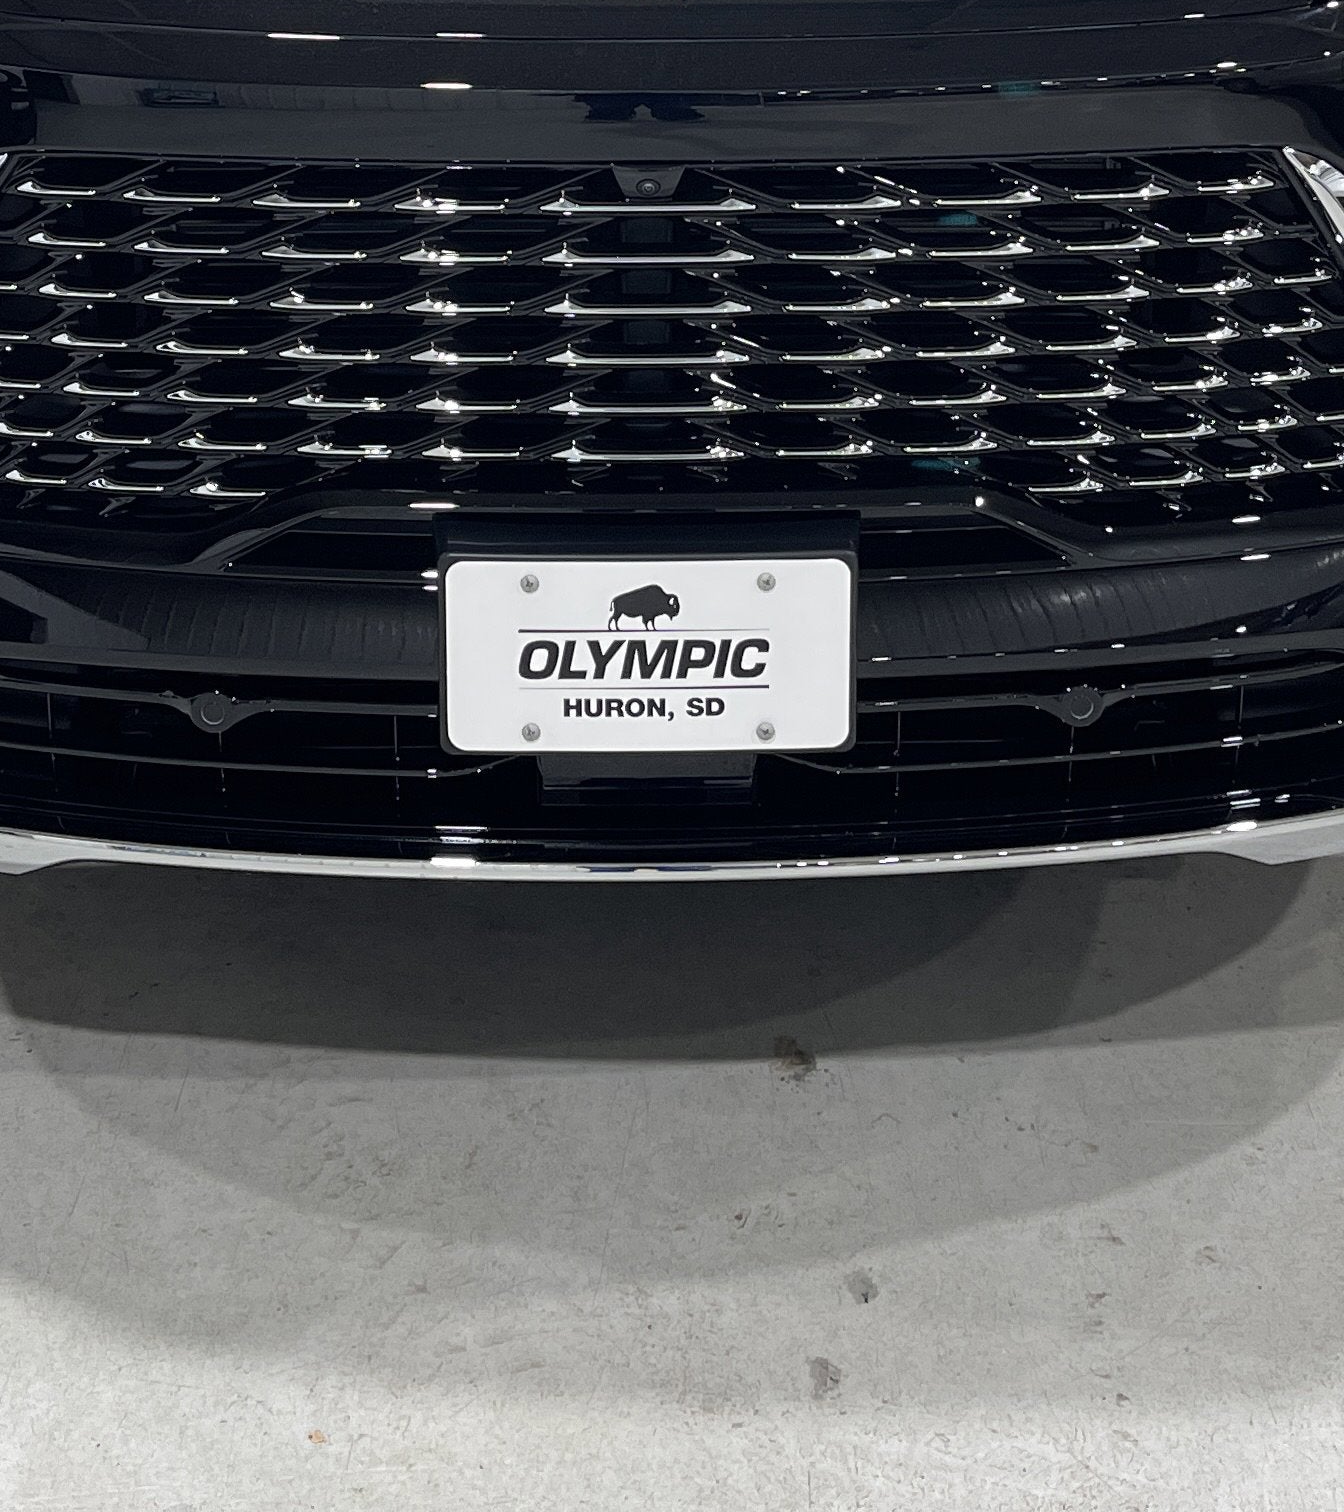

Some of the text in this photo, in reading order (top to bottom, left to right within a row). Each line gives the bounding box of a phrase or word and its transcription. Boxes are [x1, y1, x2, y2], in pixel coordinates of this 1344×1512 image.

[518, 638, 770, 680] OLYMPIC
[562, 696, 726, 721] HURON, SD
